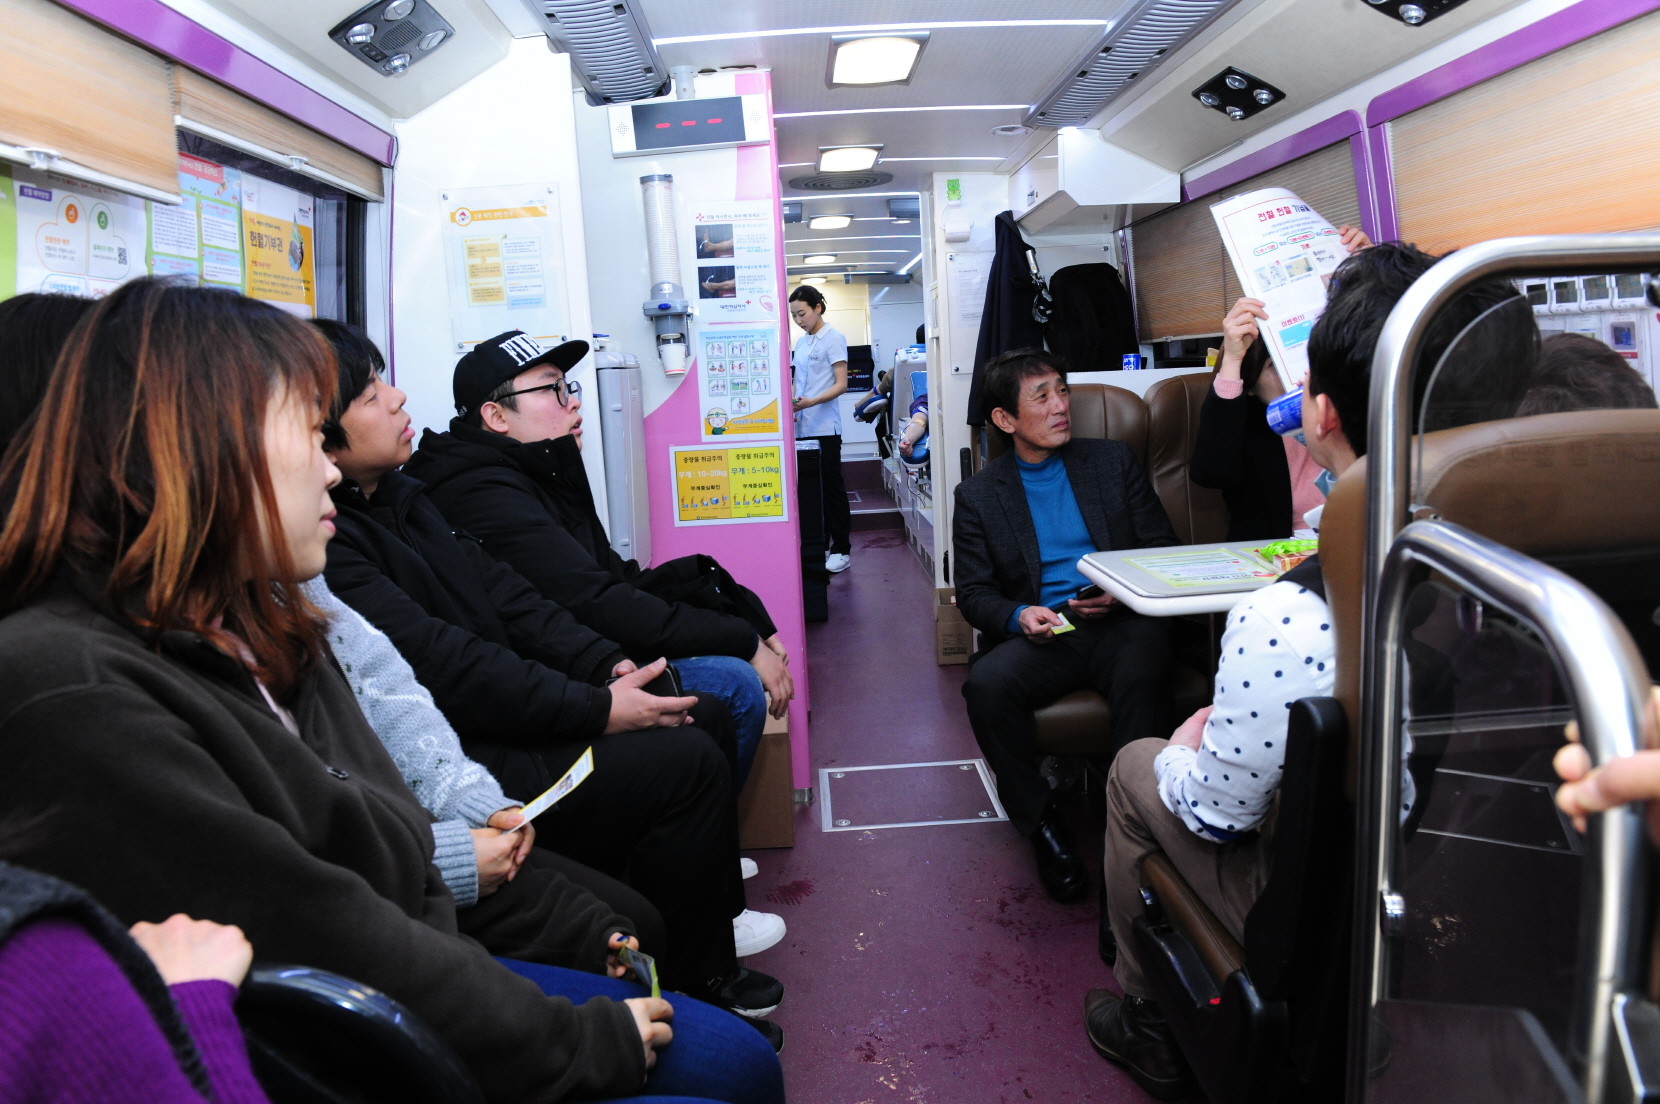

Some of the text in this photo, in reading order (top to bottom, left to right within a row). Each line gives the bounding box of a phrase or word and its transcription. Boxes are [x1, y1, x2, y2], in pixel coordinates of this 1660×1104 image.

[249, 231, 284, 253] 헌혈기부권
[701, 455, 723, 463] 취급주의
[731, 467, 745, 475] 무게
[751, 466, 780, 474] 5~10kg
[678, 471, 692, 479] 무게
